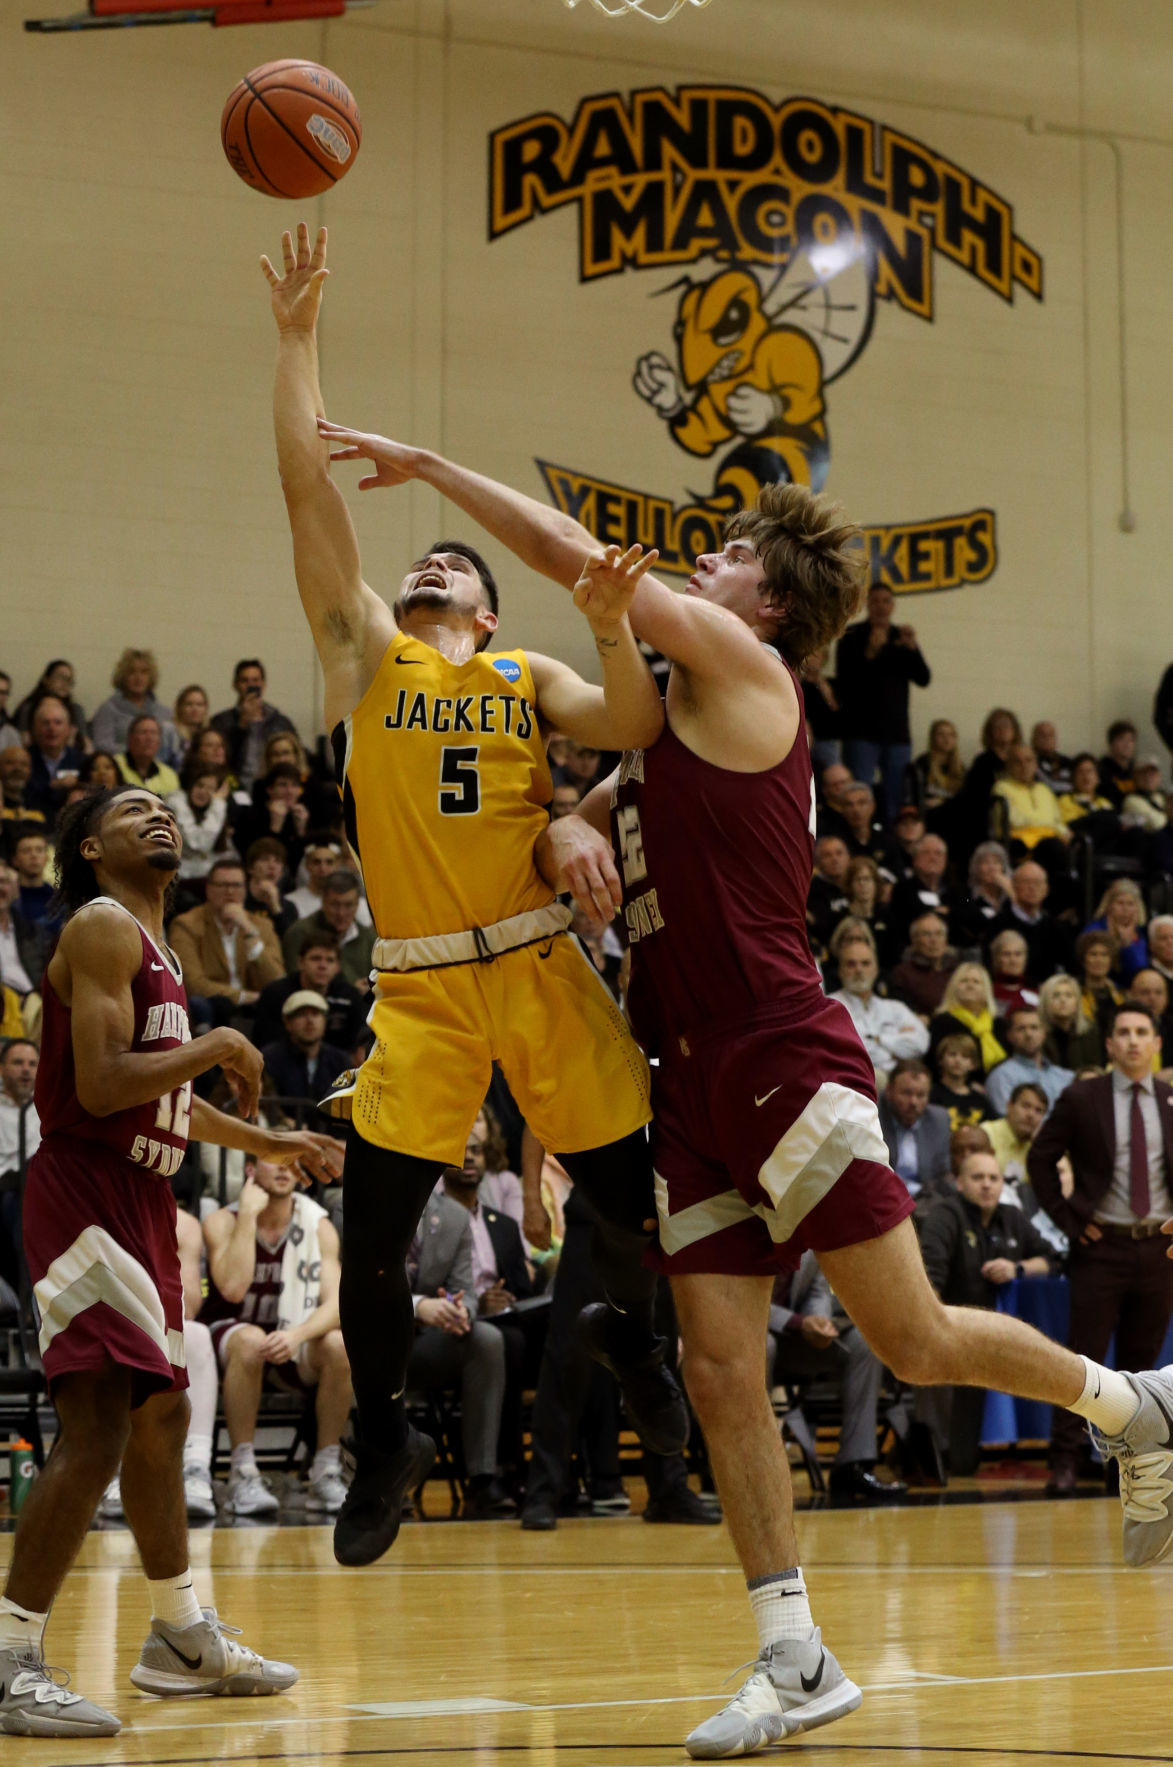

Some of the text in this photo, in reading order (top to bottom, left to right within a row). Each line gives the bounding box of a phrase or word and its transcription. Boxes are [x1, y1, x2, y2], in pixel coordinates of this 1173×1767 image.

[579, 168, 934, 322] MACON
[540, 463, 730, 578] YELLO
[384, 688, 534, 740] JACKETS
[438, 745, 482, 816] 5
